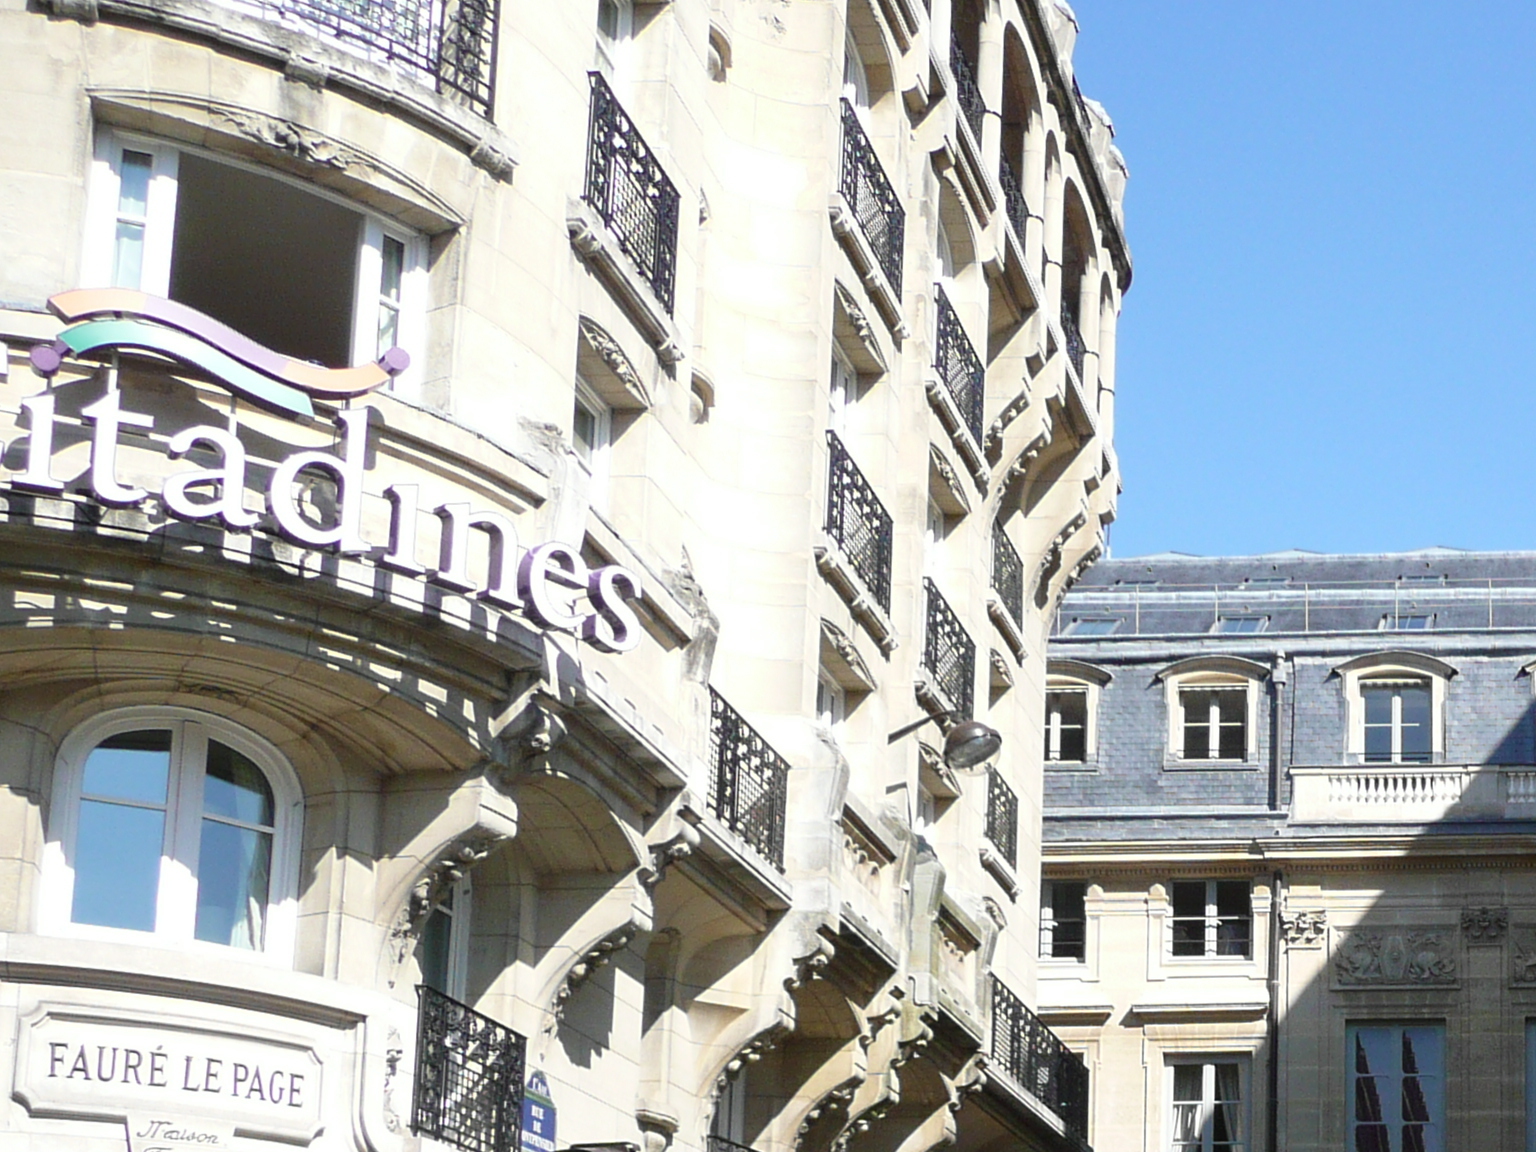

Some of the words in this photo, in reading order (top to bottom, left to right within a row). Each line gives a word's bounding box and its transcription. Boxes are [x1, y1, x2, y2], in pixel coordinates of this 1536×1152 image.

[0, 345, 645, 656] itadines
[47, 1042, 168, 1087] FAURÉ
[182, 1055, 223, 1093] LE
[231, 1062, 305, 1108] PAGE
